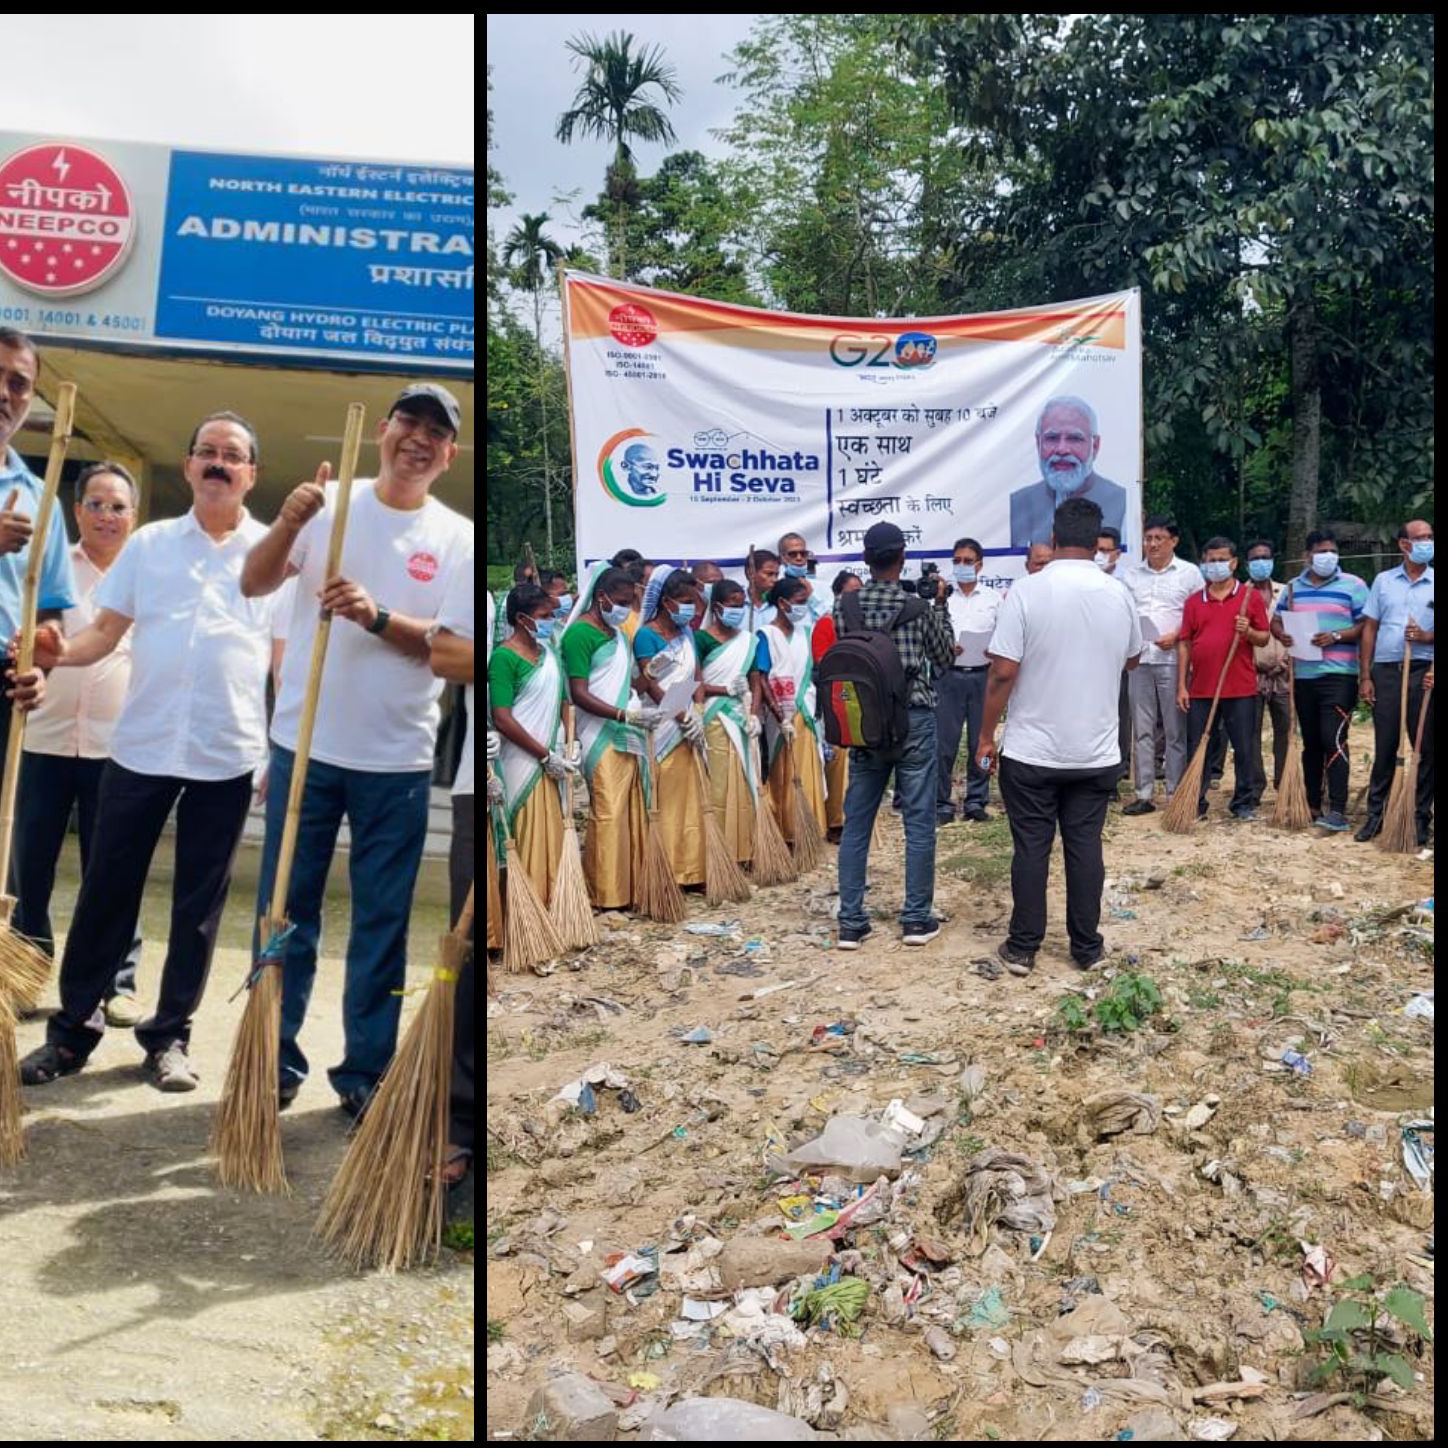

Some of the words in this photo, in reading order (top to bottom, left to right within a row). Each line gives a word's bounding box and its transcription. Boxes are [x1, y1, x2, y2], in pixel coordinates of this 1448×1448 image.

[5, 178, 113, 212] नीपको
[209, 178, 283, 194] NORTH
[288, 183, 379, 200] EASTERN
[384, 190, 474, 206] ELECTRIC
[176, 214, 474, 257] ADMINISTRA
[206, 305, 285, 323] DOYANG
[290, 312, 356, 327] HYDRO
[361, 317, 446, 333] ELECTRIC
[837, 409, 844, 423] 1
[850, 408, 899, 428] अक्टूबर
[902, 403, 921, 423] को
[924, 408, 953, 428] सुबह
[956, 408, 970, 421] 10
[667, 448, 819, 471] Swachhata
[835, 436, 870, 461] एक
[874, 436, 913, 455] साथ
[693, 472, 722, 492] Hi
[729, 473, 796, 493] Seva
[838, 468, 847, 487] 1
[855, 460, 883, 486] घंटे
[838, 496, 901, 517] स्वच्छता
[904, 495, 922, 512] के
[925, 493, 954, 515] लिए
